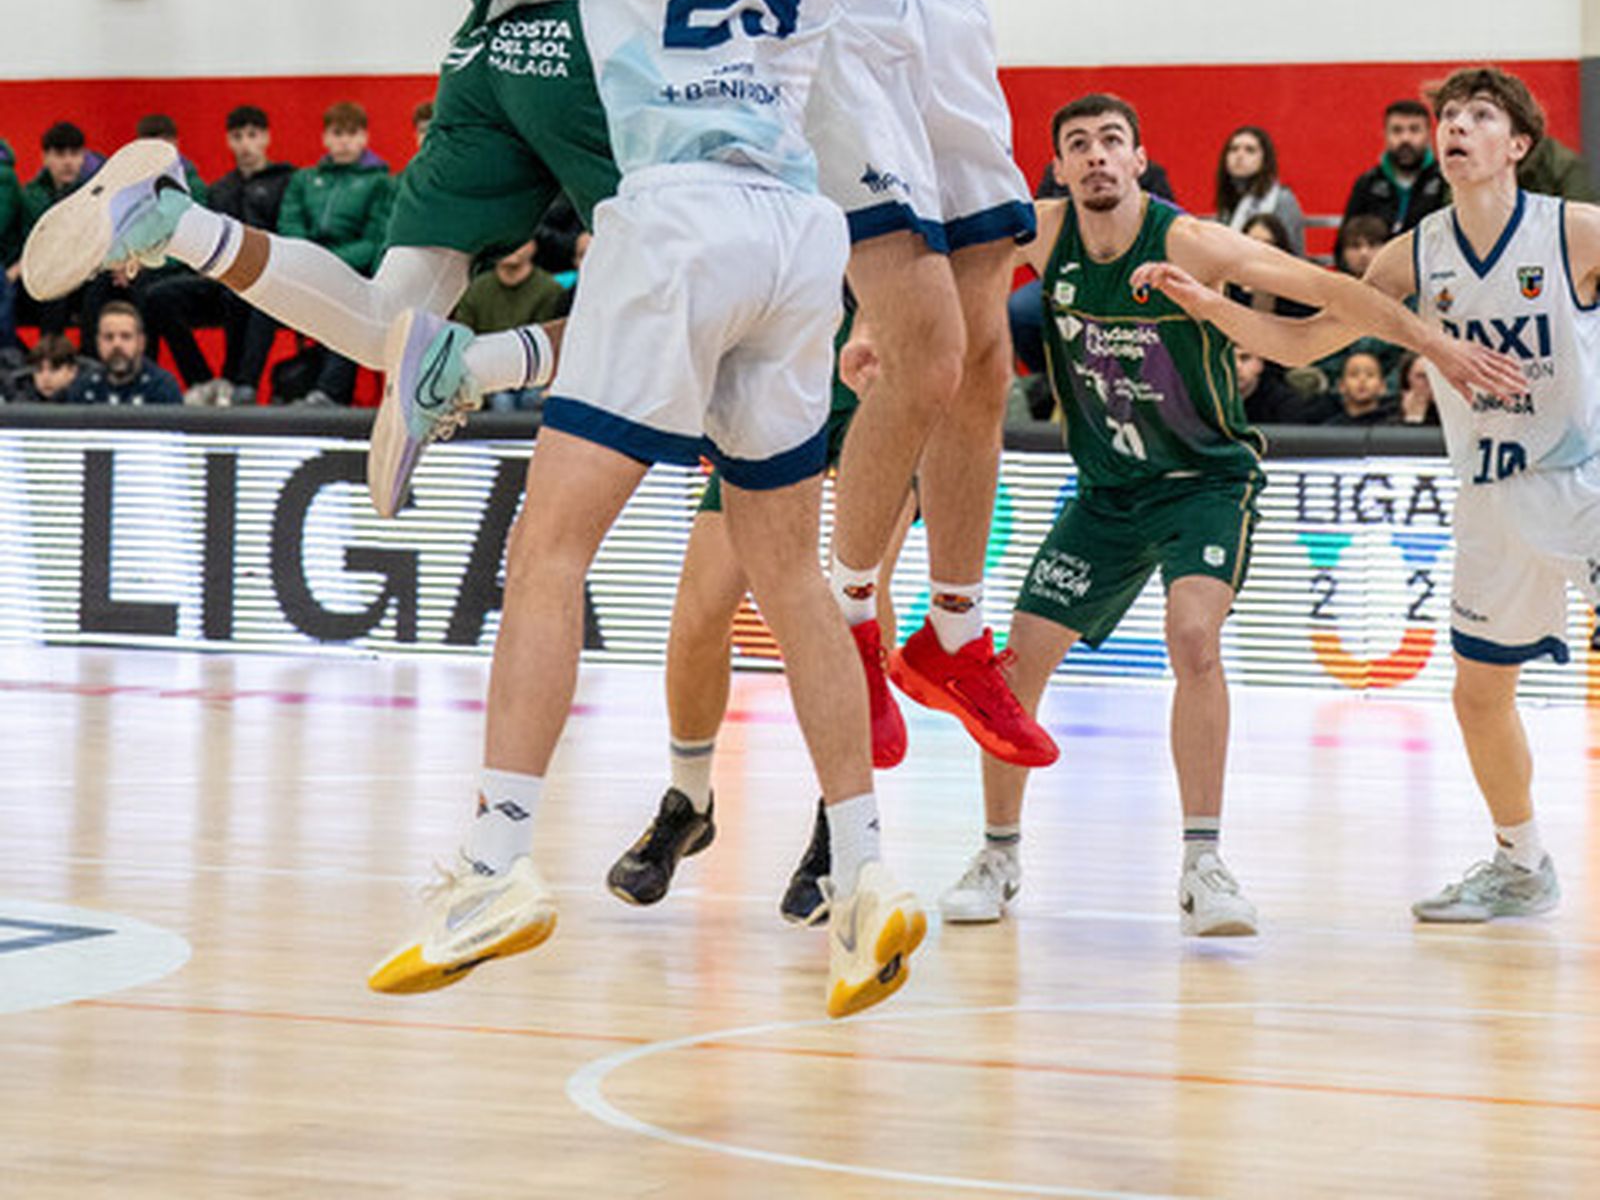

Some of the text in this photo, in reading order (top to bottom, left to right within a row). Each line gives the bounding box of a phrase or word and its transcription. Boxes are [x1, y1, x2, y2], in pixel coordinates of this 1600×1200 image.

[490, 36, 571, 60] DEL SOL
[498, 19, 573, 39] COSTA
[1296, 471, 1451, 528] LIGA
[1405, 567, 1437, 622] 2
